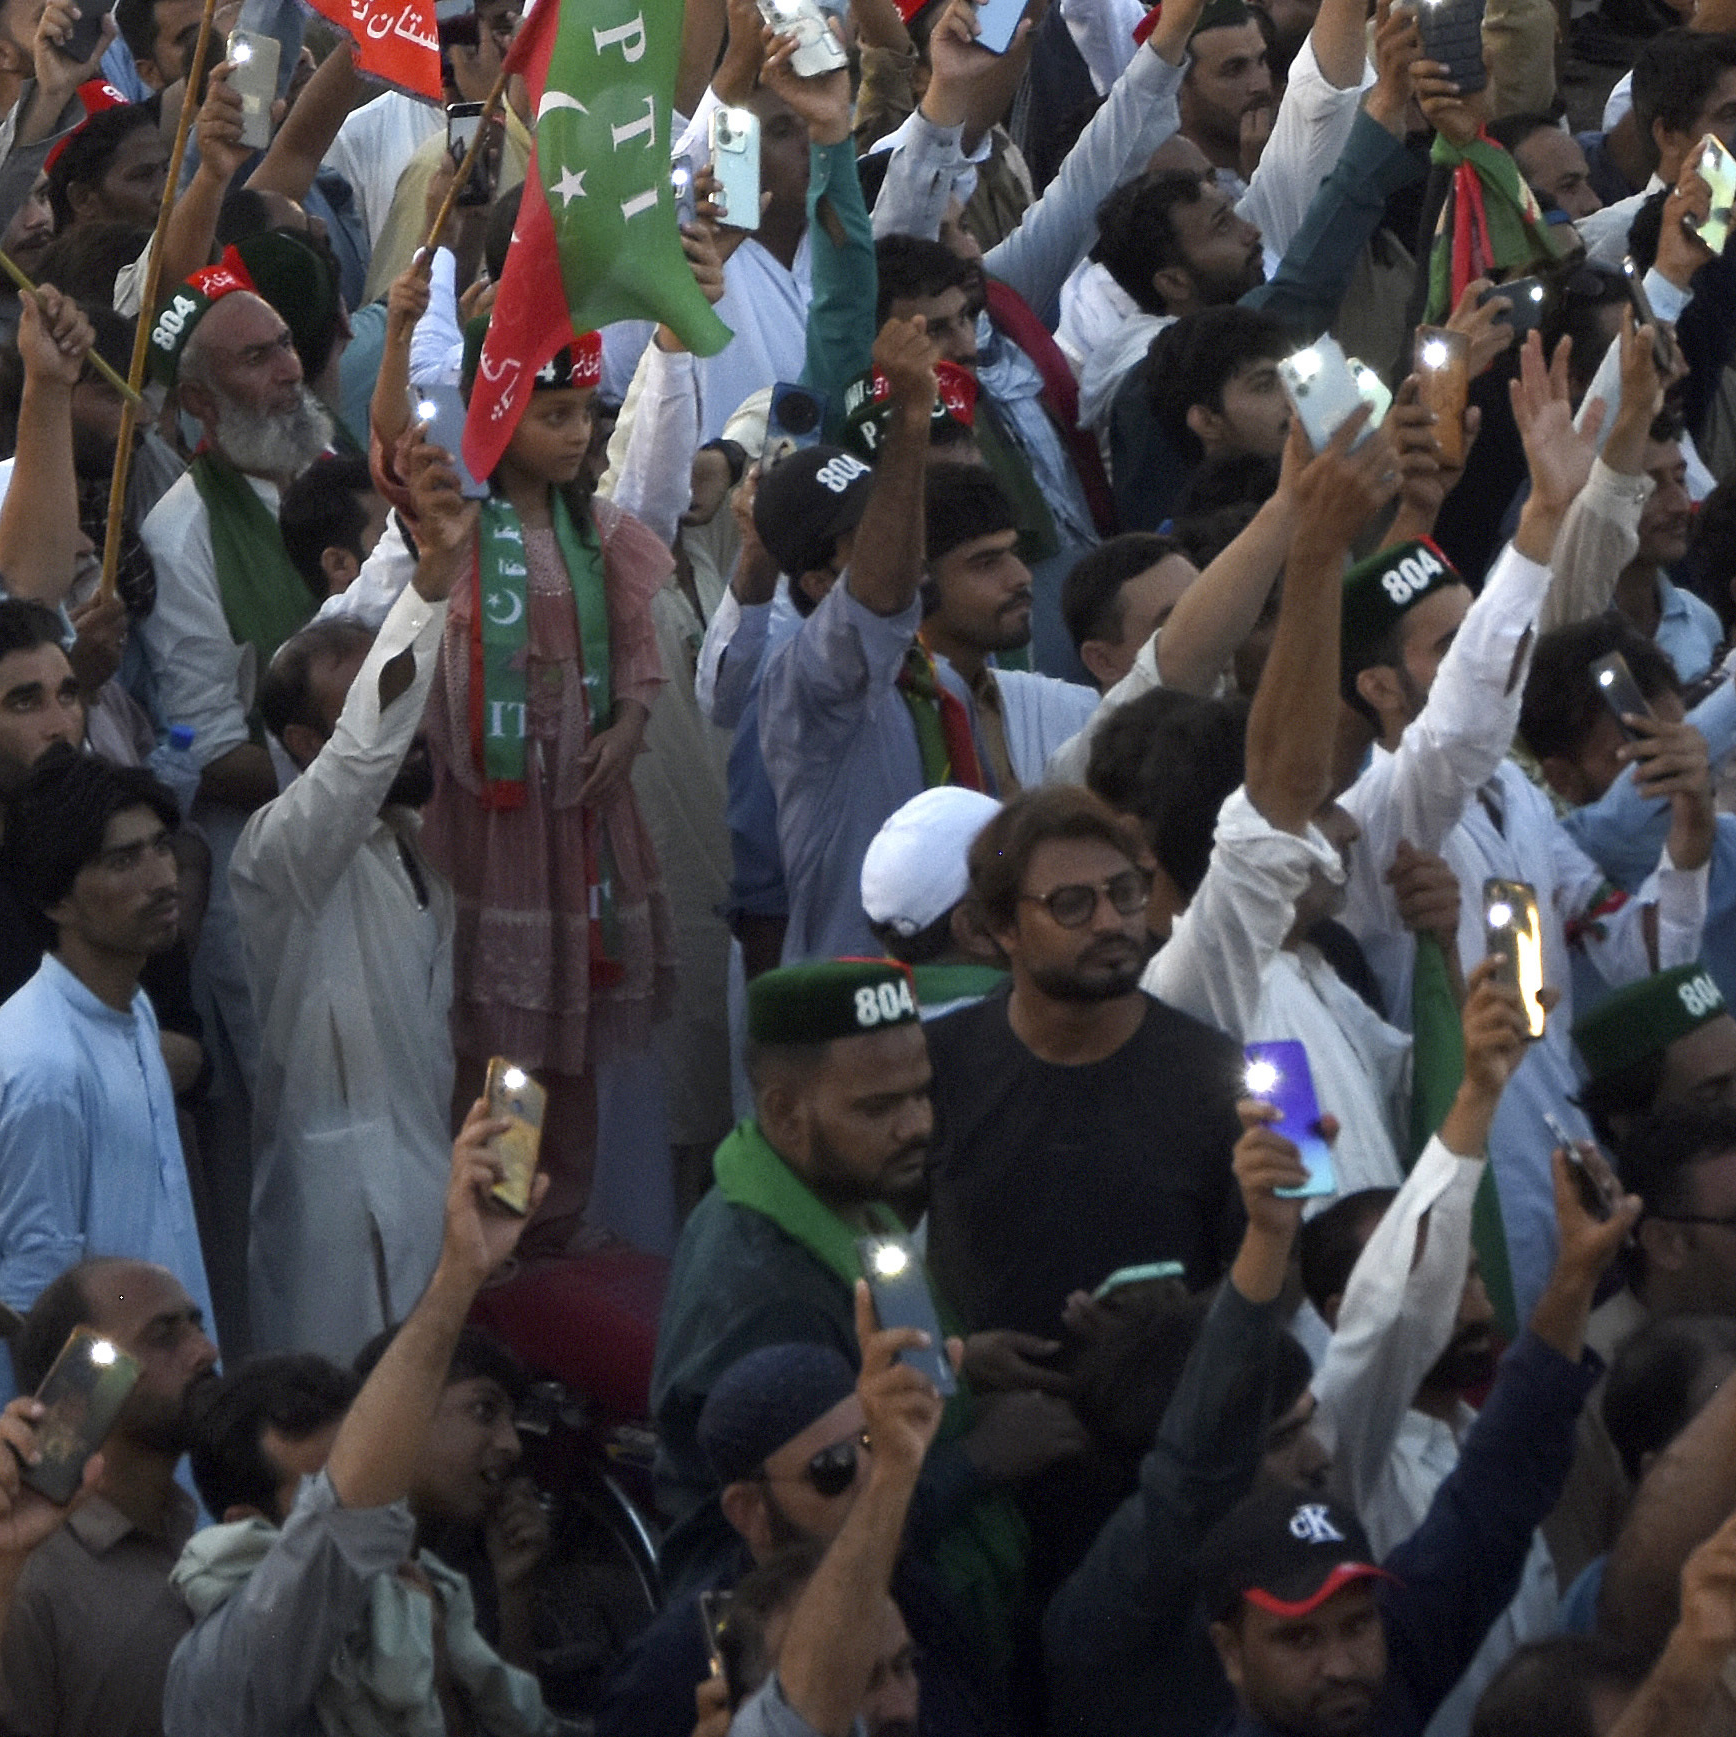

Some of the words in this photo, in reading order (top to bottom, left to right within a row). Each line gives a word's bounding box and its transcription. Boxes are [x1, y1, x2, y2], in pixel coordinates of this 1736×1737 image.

[366, 5, 440, 52] ستان
[593, 10, 659, 225] PTI
[152, 294, 198, 350] 804
[815, 453, 871, 493] 804
[1381, 547, 1445, 605] 804
[854, 977, 916, 1027] 804
[1678, 972, 1724, 1017] 804
